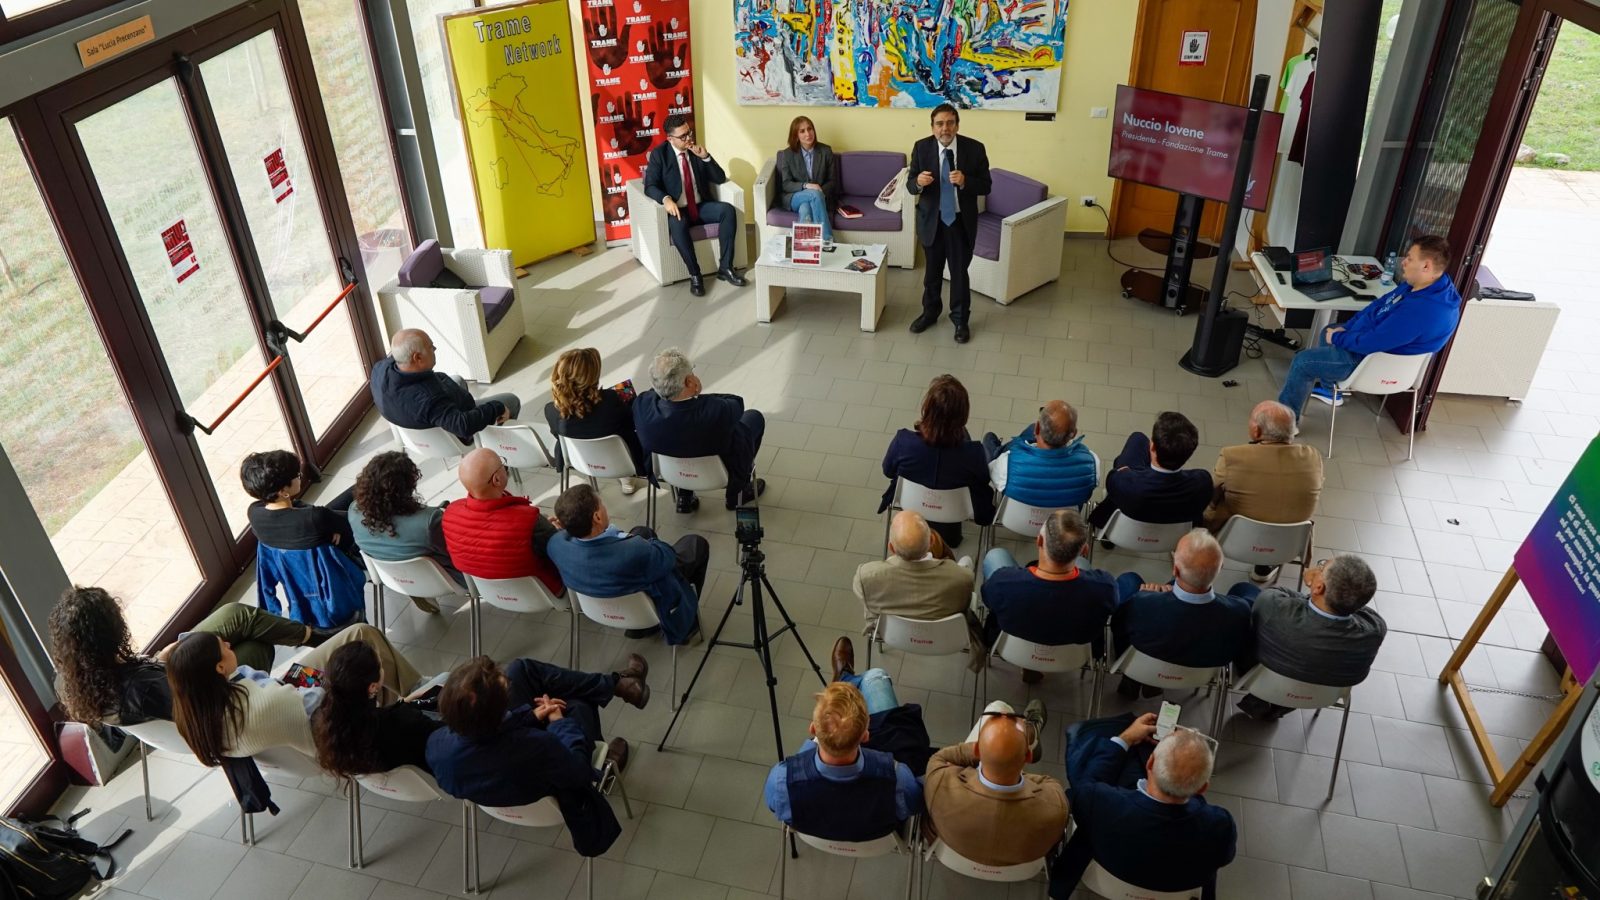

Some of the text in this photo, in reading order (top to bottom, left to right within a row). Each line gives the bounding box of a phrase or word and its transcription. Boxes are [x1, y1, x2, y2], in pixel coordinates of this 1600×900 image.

[625, 15, 652, 23] TRAME
[473, 16, 531, 43] Trame
[663, 31, 688, 40] TRAME
[591, 38, 617, 47] TRAME
[86, 45, 99, 57] Sala
[504, 33, 562, 66] Network
[629, 54, 655, 62] TRAME
[665, 69, 690, 78] TRAME
[595, 77, 621, 85] TRAME
[632, 92, 657, 100] TRAME
[668, 106, 692, 114] TRAME
[600, 114, 624, 123] TRAME
[1123, 111, 1205, 140] Nuccio Iovene
[636, 128, 660, 137] TRAME
[1121, 130, 1157, 144] Presidente
[1161, 139, 1205, 154] Fondazione
[1206, 147, 1229, 159] Trame
[603, 150, 628, 159] TRAME
